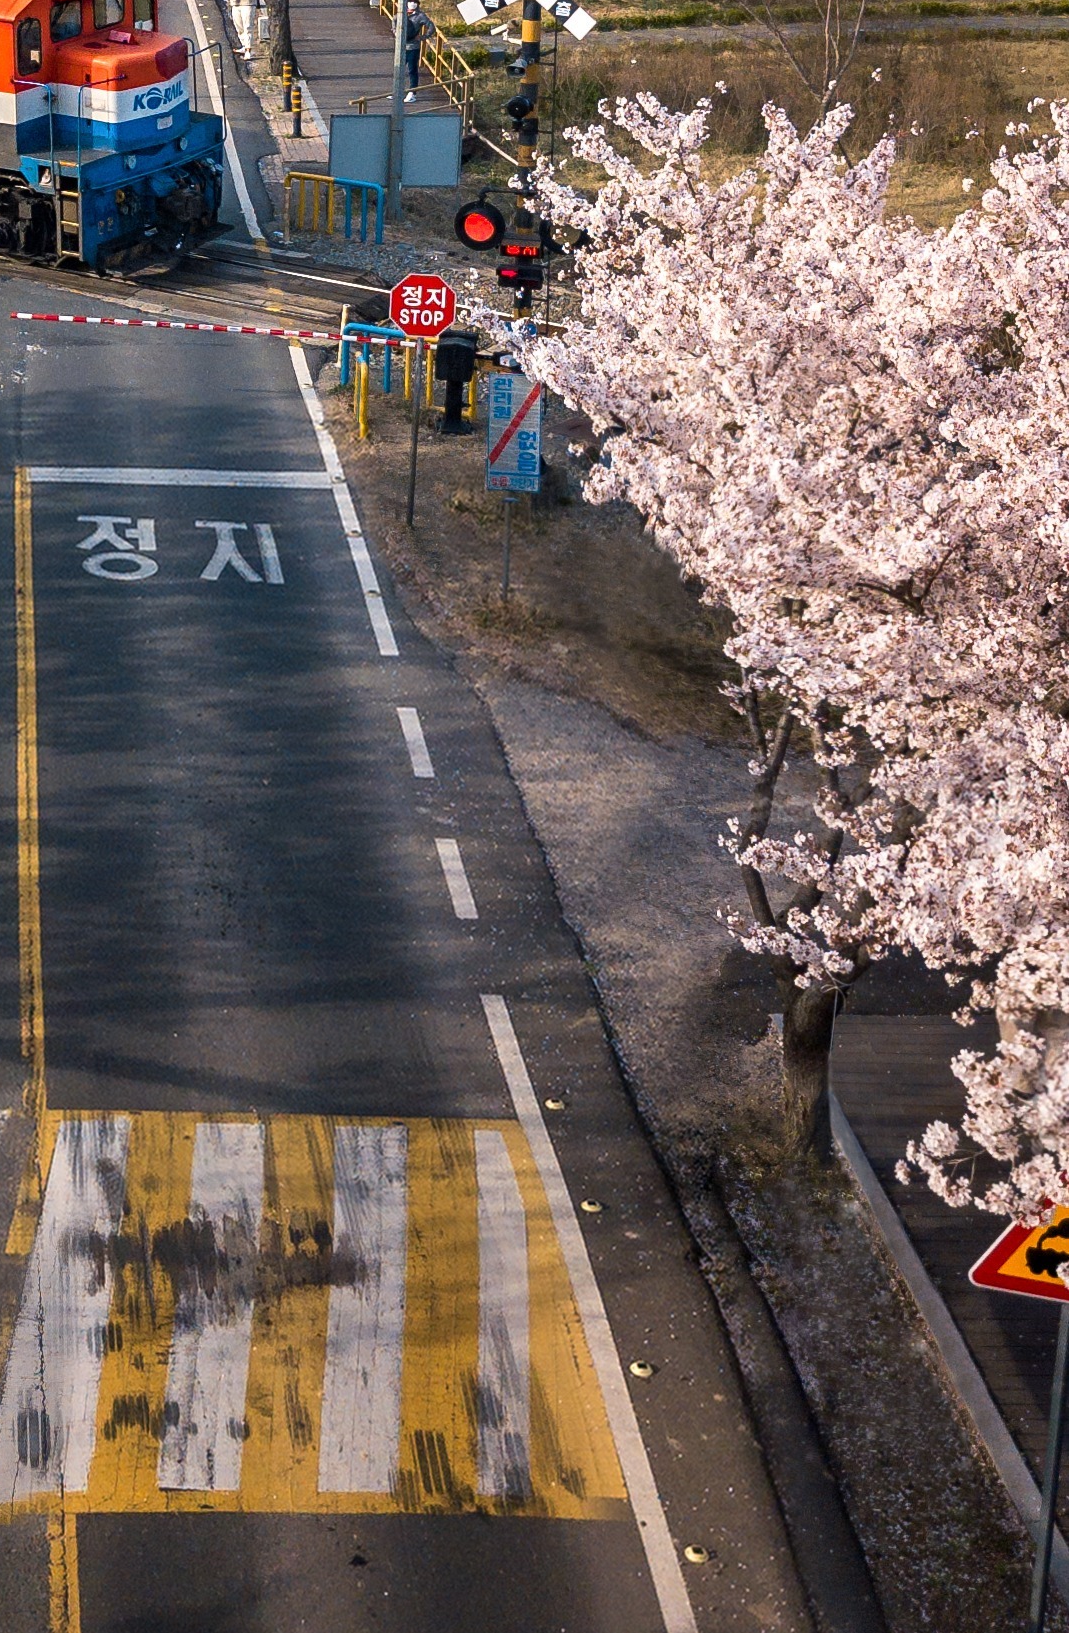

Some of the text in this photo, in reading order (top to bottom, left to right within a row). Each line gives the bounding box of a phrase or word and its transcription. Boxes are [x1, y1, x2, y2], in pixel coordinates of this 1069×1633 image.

[133, 80, 184, 112] KORAIL
[400, 285, 447, 309] 정지
[399, 308, 444, 327] STOP
